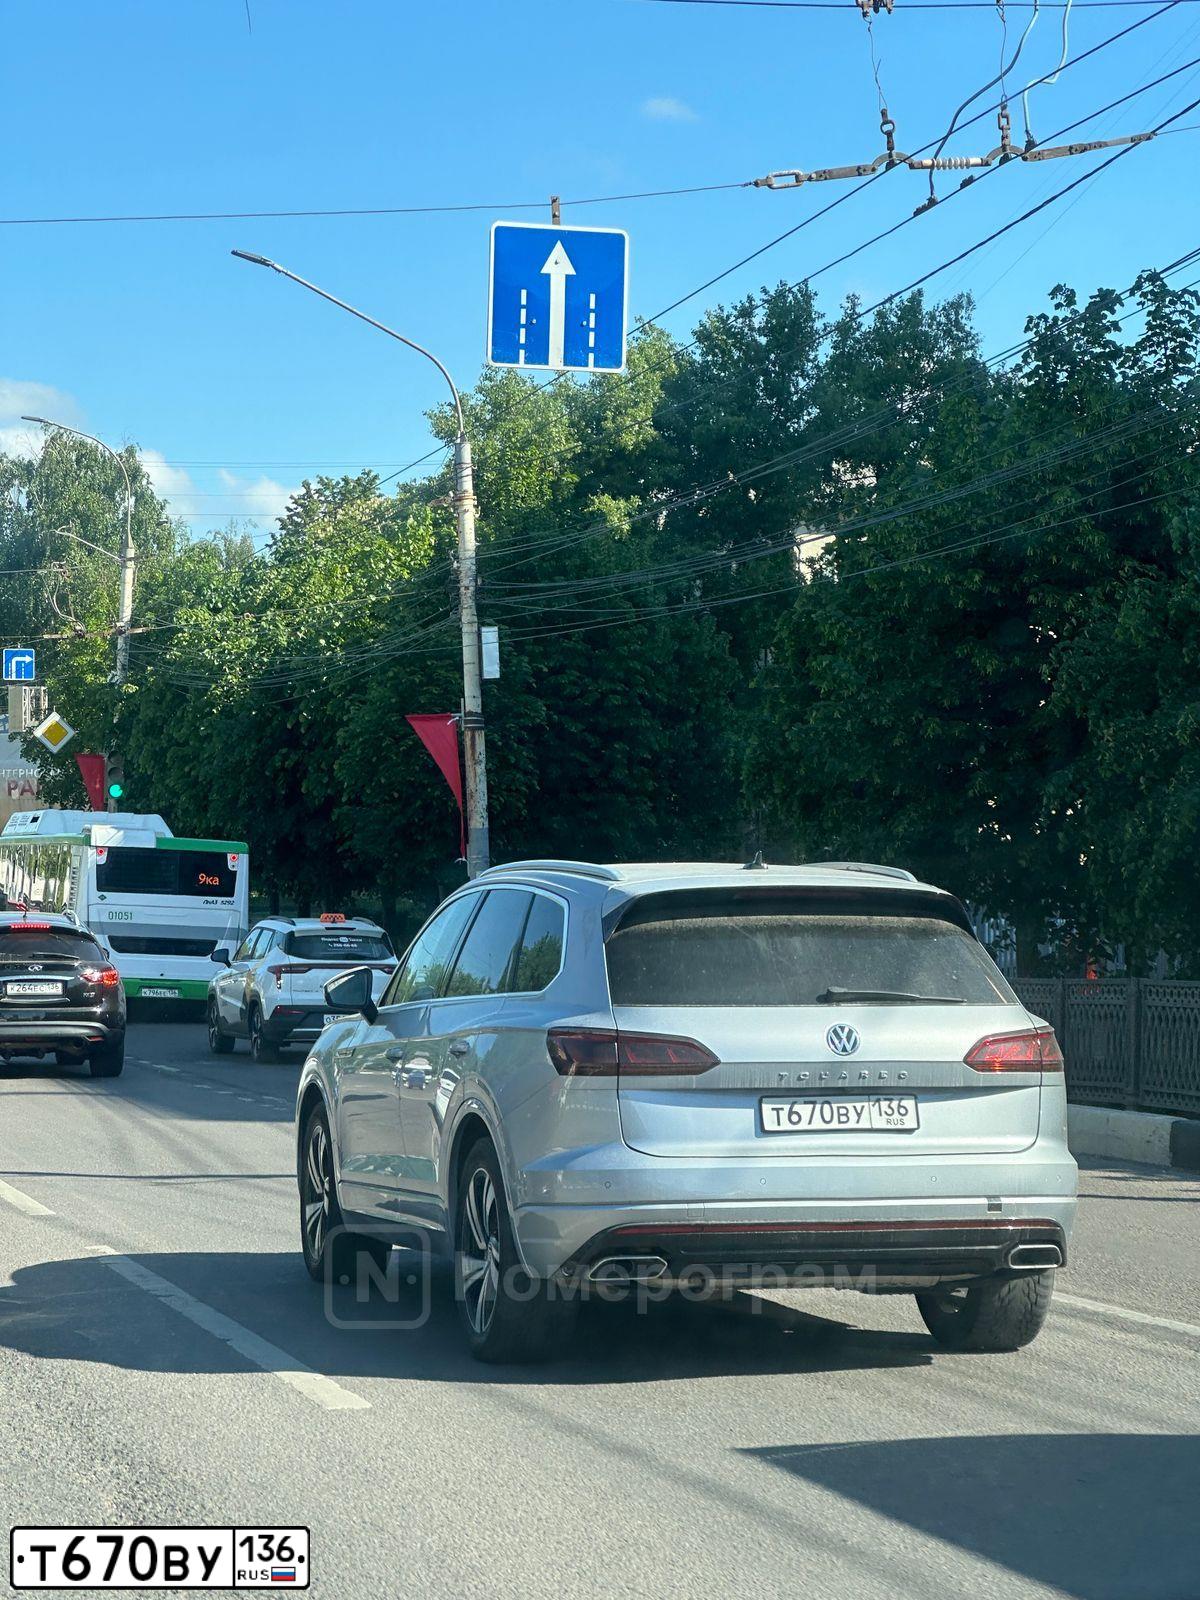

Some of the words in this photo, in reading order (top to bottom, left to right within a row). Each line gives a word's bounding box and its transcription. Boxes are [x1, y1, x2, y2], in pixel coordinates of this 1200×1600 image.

[198, 873, 220, 886] 9ка
[108, 911, 133, 921] 01051
[778, 1071, 909, 1082] TOUAREG
[771, 1100, 865, 1126] Т670ВУ
[872, 1097, 909, 1118] 136
[886, 1117, 906, 1126] RUS
